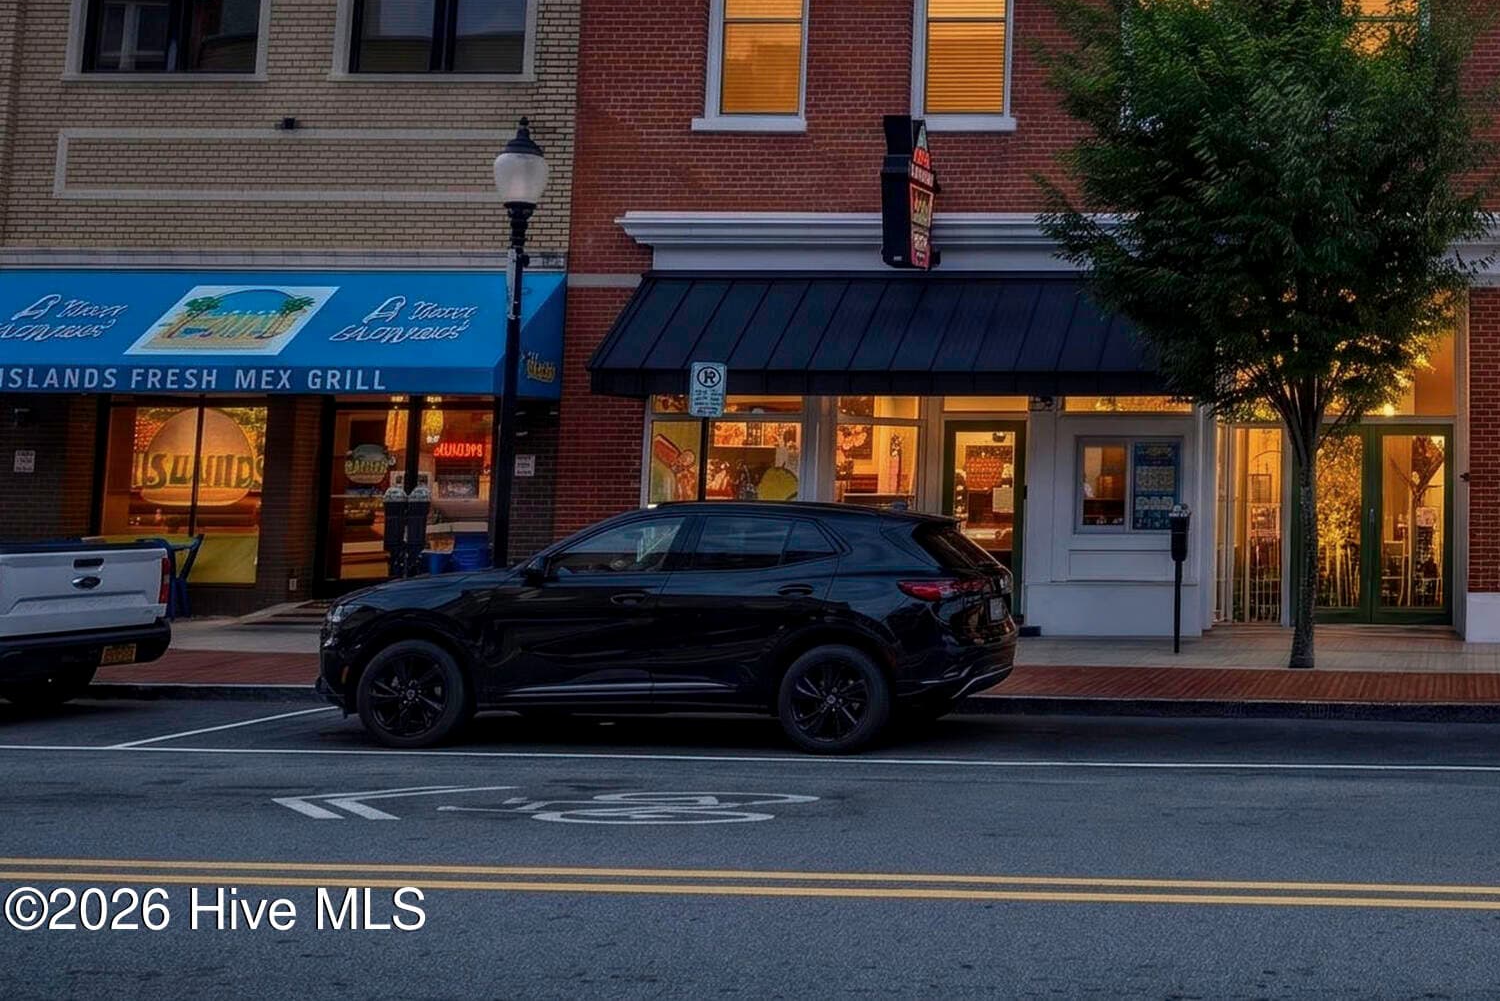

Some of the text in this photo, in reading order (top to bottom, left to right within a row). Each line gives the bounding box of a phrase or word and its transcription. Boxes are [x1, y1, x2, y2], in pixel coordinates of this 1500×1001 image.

[0, 367, 386, 390] ISLANDS FRESH MEX GRILL
